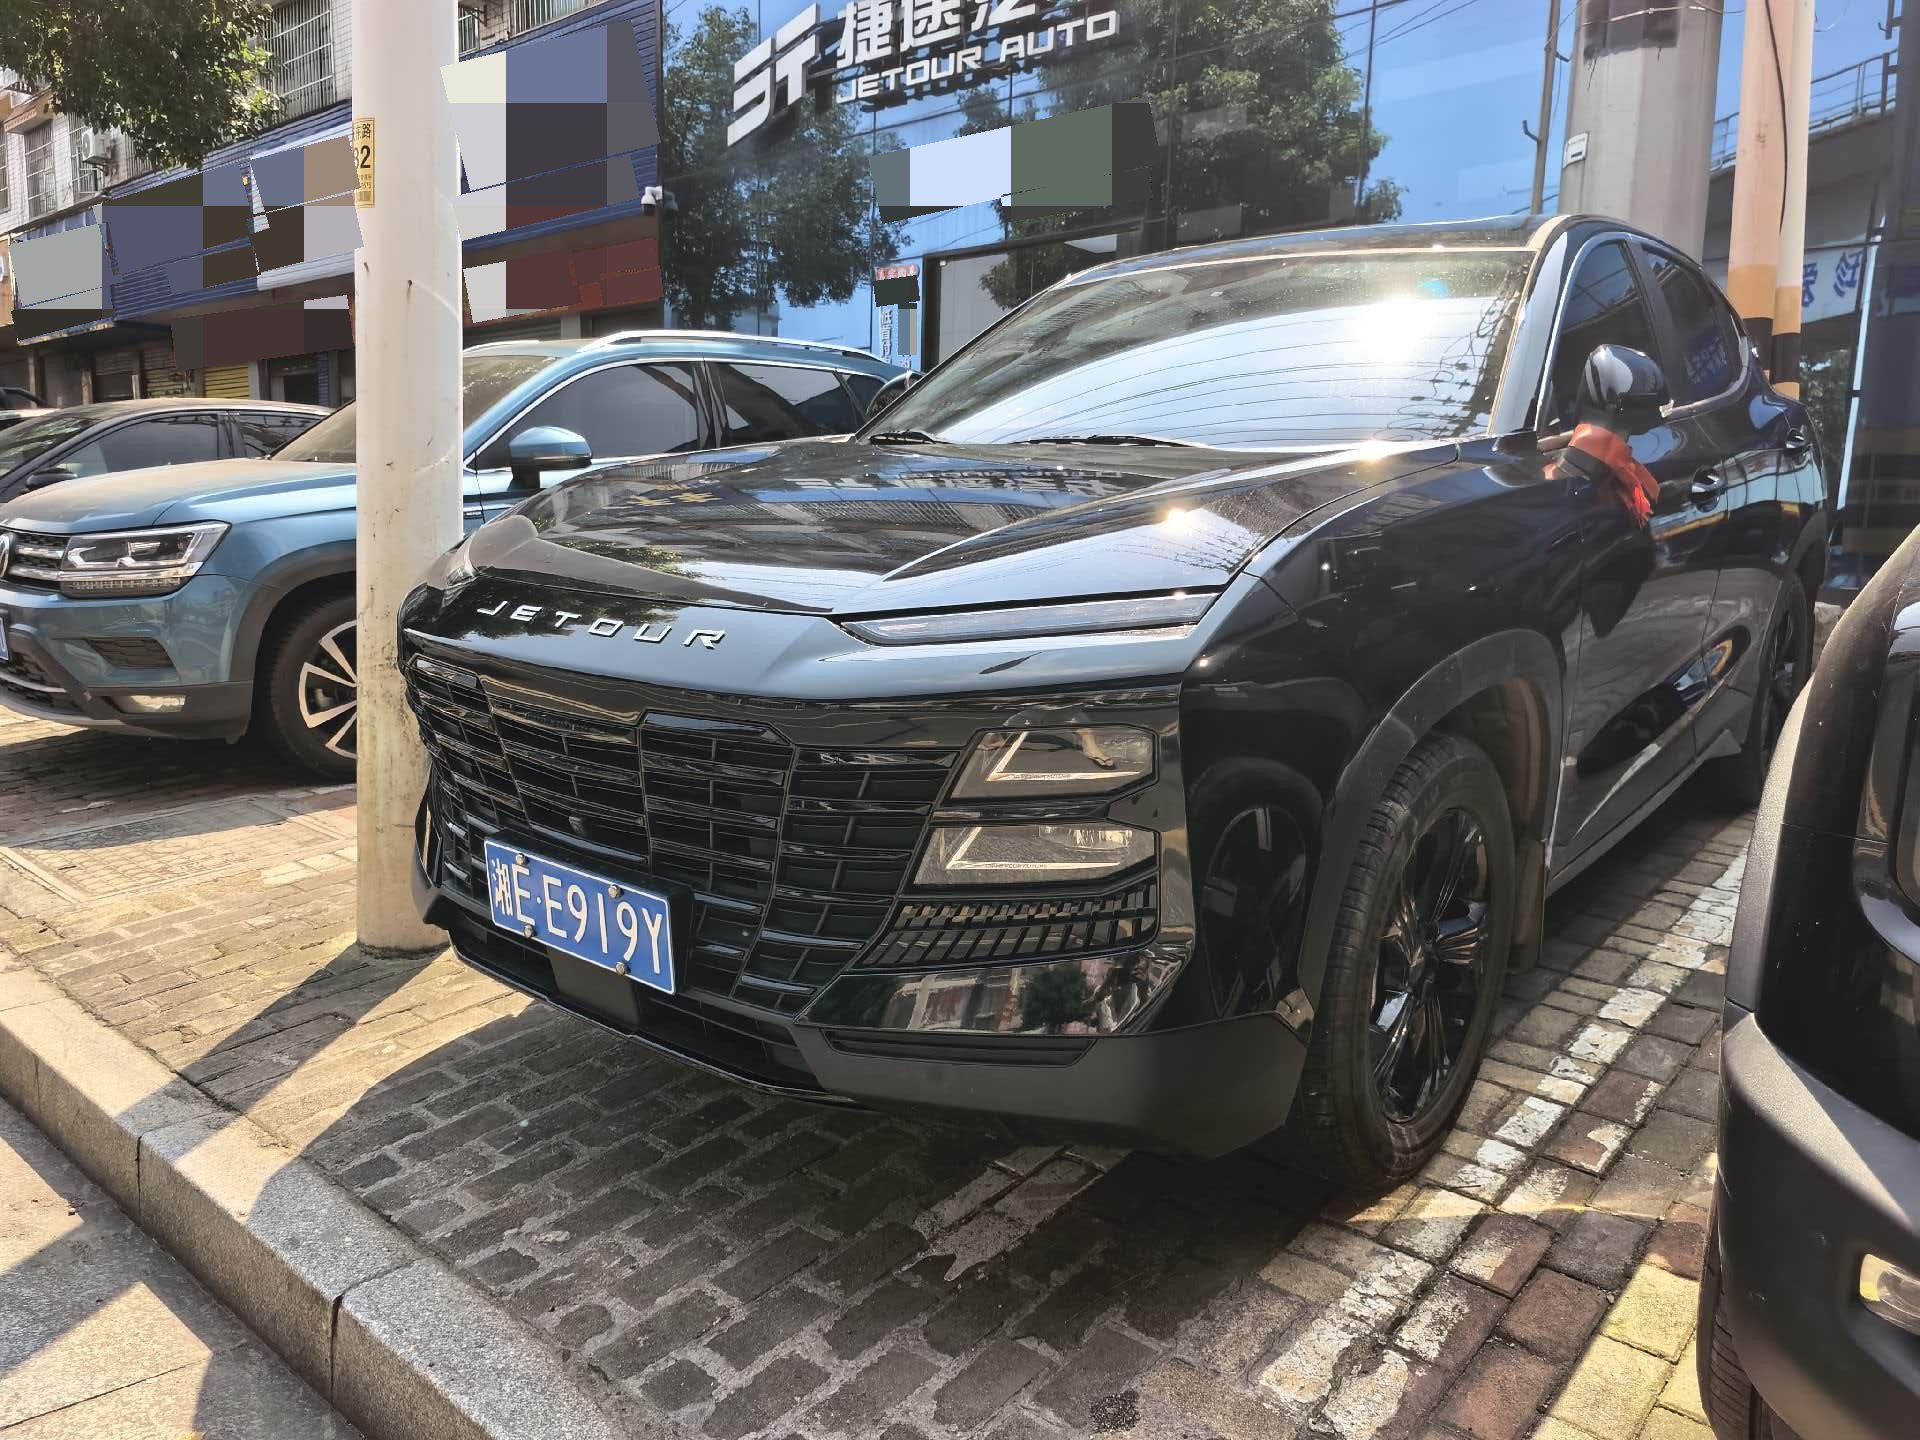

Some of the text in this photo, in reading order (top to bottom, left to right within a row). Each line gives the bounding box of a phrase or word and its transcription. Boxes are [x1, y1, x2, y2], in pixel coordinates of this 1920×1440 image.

[836, 0, 1036, 69] 捷途
[837, 10, 1118, 103] JETOUR AUTO
[477, 600, 726, 650] JETOUR
